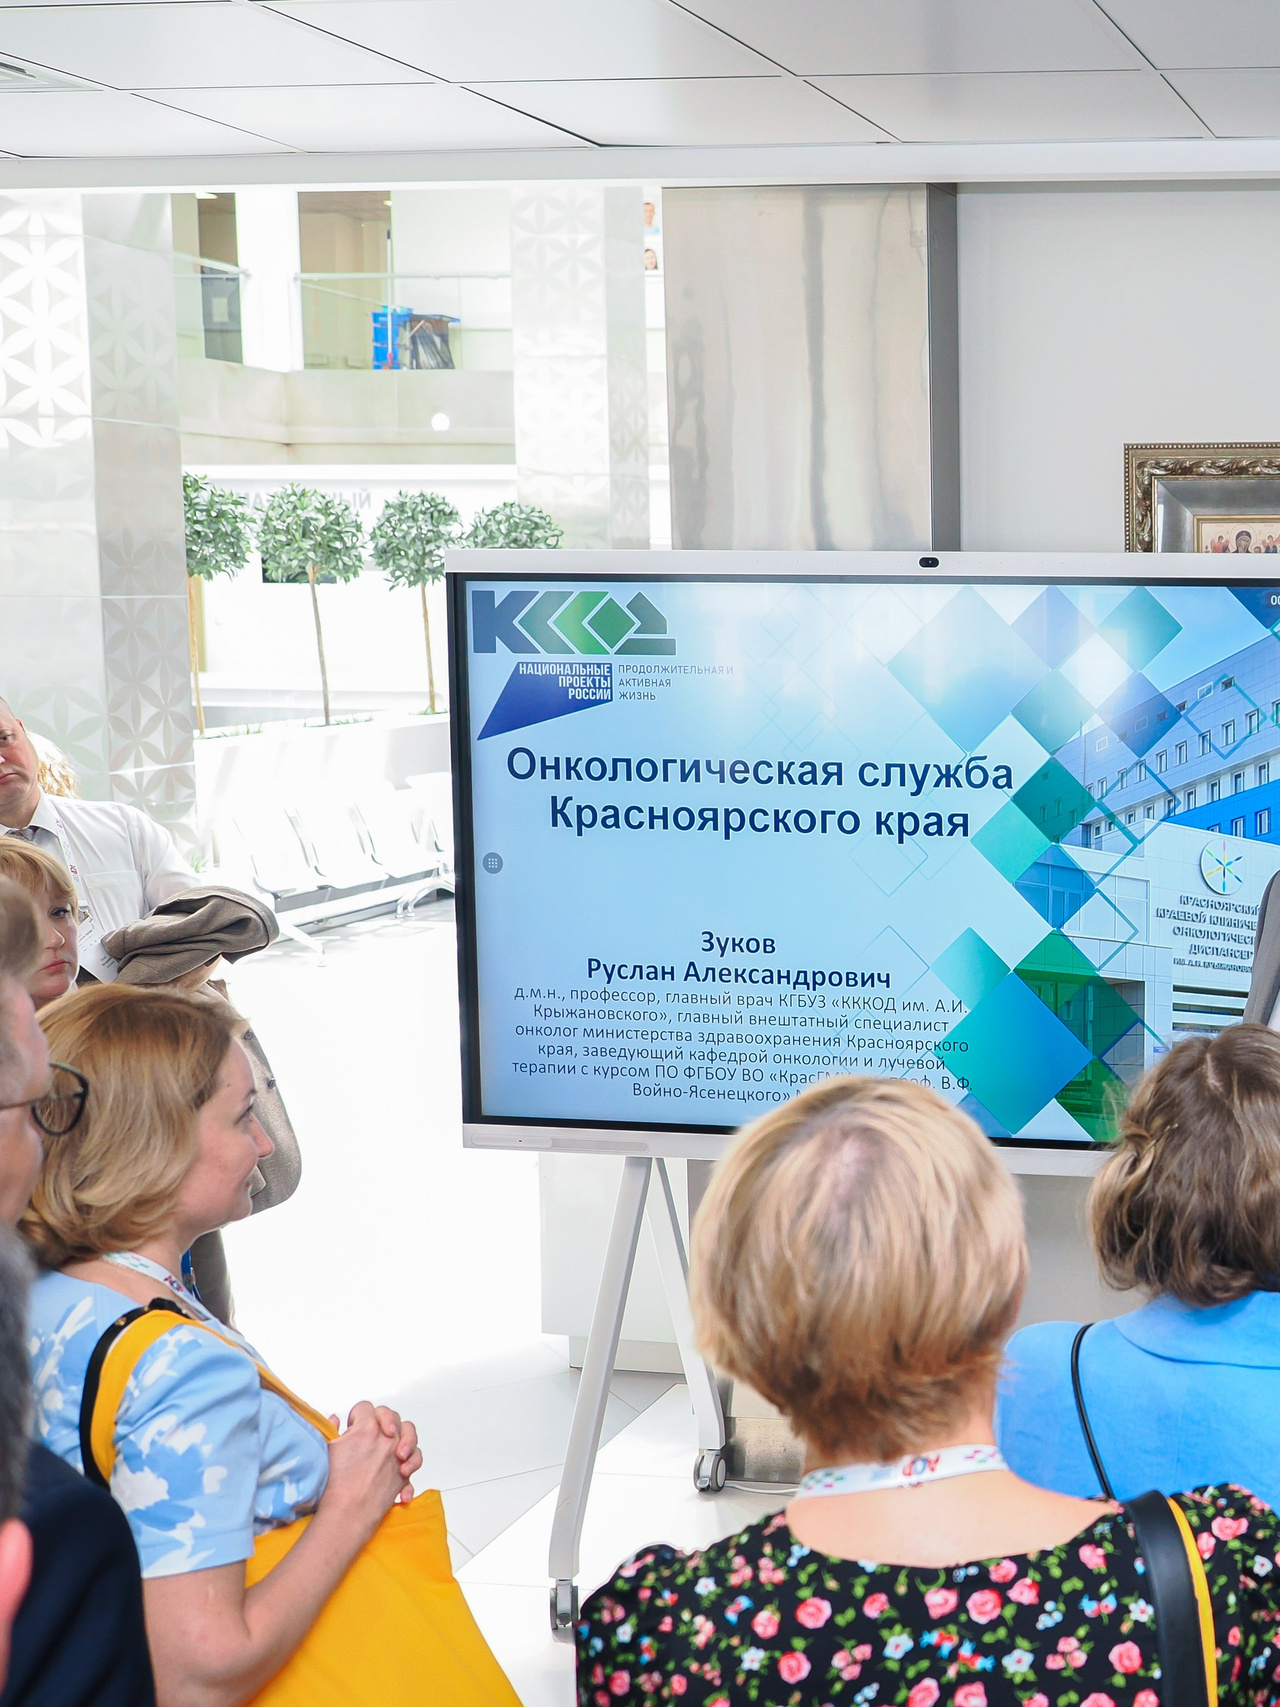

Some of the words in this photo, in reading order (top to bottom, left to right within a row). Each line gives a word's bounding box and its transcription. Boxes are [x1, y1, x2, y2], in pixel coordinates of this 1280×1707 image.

[519, 663, 610, 676] НАЦИОНАЛЬНЫЕ
[558, 676, 611, 688] ПРОЕКТЫ
[618, 664, 724, 676] ПРОДОЛЖИТЕЛЬНАЯ
[618, 678, 671, 688] АКТИВНАЯ
[568, 688, 611, 700] РОССИИ
[619, 690, 656, 701] ЖИЗНЬ
[507, 747, 843, 786] Онкологическая
[857, 756, 1014, 797] служба
[550, 796, 861, 840] Красноярского
[875, 807, 970, 844] края
[1209, 915, 1258, 931] КЛИНИЧЕ
[701, 930, 776, 957] Зуков
[587, 957, 675, 984] Руслан
[683, 961, 891, 991] Александрович
[514, 987, 566, 1002] д.м.н.,
[570, 987, 660, 1005] профессор,
[665, 991, 732, 1005] главный
[737, 996, 773, 1008] врач
[779, 994, 826, 1009] КГБУЗ
[831, 996, 897, 1013] «КККОД
[902, 1002, 929, 1012] им.
[934, 999, 968, 1014] А.И.
[534, 1004, 672, 1024] Крыжановского»,
[677, 1010, 743, 1025] главный
[749, 1013, 849, 1029] внештатный
[854, 1018, 949, 1033] специалист
[515, 1025, 579, 1038] онколог
[583, 1027, 693, 1043] министерства
[697, 1031, 841, 1048] здравоохранения
[847, 1034, 969, 1053] Красноярского
[538, 1043, 578, 1058] края,
[582, 1045, 684, 1061] заведующий
[689, 1048, 768, 1065] кафедрой
[773, 1054, 859, 1068] онкологии
[864, 1057, 873, 1068] и
[878, 1056, 945, 1071] лучевой
[512, 1061, 576, 1076] терапии
[581, 1065, 589, 1076] с
[593, 1065, 650, 1080] курсом
[655, 1065, 678, 1079] ПО
[683, 1065, 737, 1081] ФГБОУ
[742, 1068, 764, 1082] ВО
[941, 1076, 973, 1091] В.Ф.
[633, 1082, 791, 1102] Войно-Ясенецкого»
